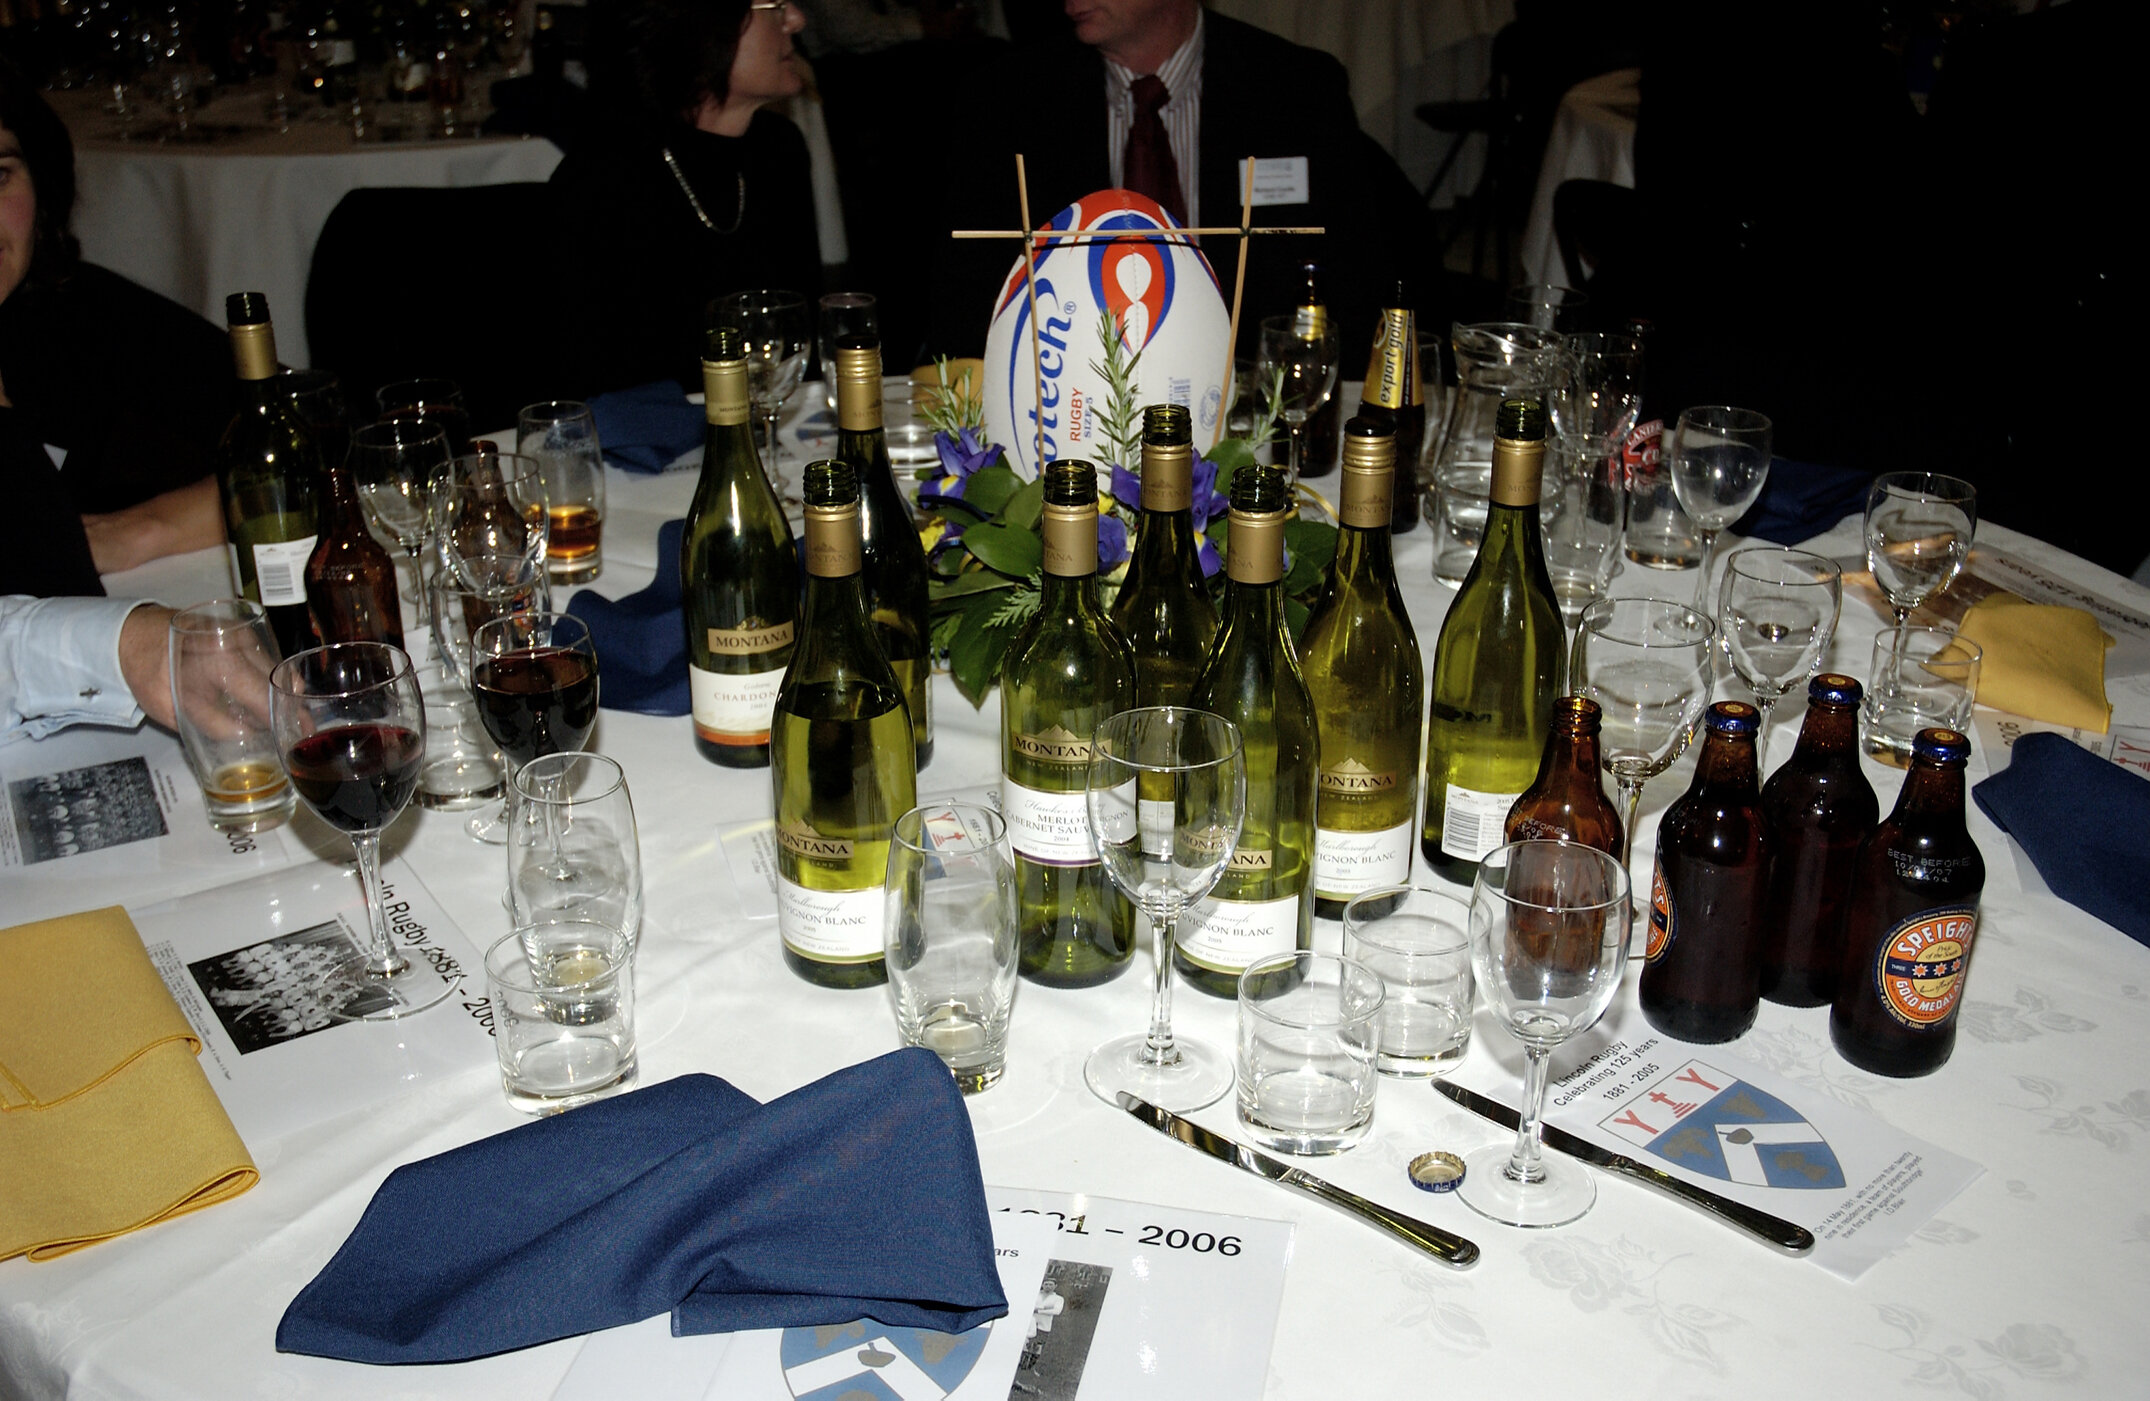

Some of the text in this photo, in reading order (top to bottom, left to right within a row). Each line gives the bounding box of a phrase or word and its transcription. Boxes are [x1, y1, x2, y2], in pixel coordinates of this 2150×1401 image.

[1380, 312, 1404, 404] export gold
[1070, 387, 1084, 442] RUGBY
[716, 630, 788, 648] MONTANA
[713, 690, 777, 702] CHARDON
[1015, 736, 1109, 757] MONTANA
[1320, 775, 1393, 788] ONTANA
[1005, 808, 1056, 834] CABERNET
[1037, 813, 1087, 826] MERLOT
[1361, 850, 1397, 864] BLANC
[1887, 848, 1971, 868] BEST BEFORE
[386, 902, 431, 947] Rugby
[825, 915, 868, 926] BLANC
[1233, 925, 1275, 937] BLANC
[1896, 980, 1919, 1008] GOLD
[1918, 992, 1955, 1012] MEDAL
[1552, 1040, 1628, 1088] Lincoln Rugby
[1553, 1038, 1659, 1106] Celebrating 125 years
[1603, 1083, 1631, 1101] 1881
[1631, 1062, 1660, 1082] 2005
[1138, 1225, 1243, 1257] 2006
